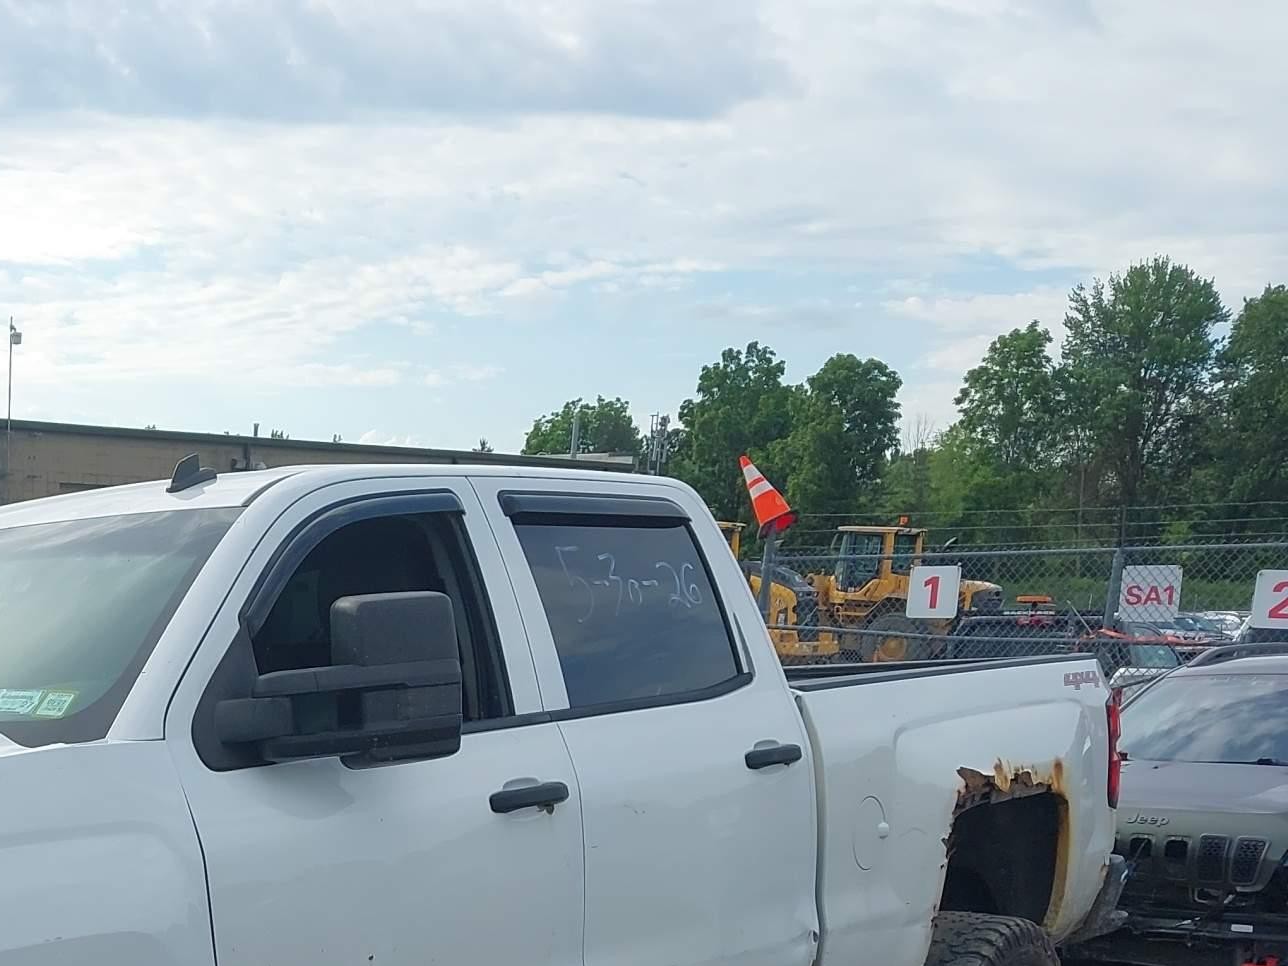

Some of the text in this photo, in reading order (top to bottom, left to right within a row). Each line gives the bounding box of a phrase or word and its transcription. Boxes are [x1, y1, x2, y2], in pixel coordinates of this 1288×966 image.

[923, 575, 940, 609] 1
[1125, 585, 1176, 606] SA1
[1127, 813, 1169, 826] Jeep
